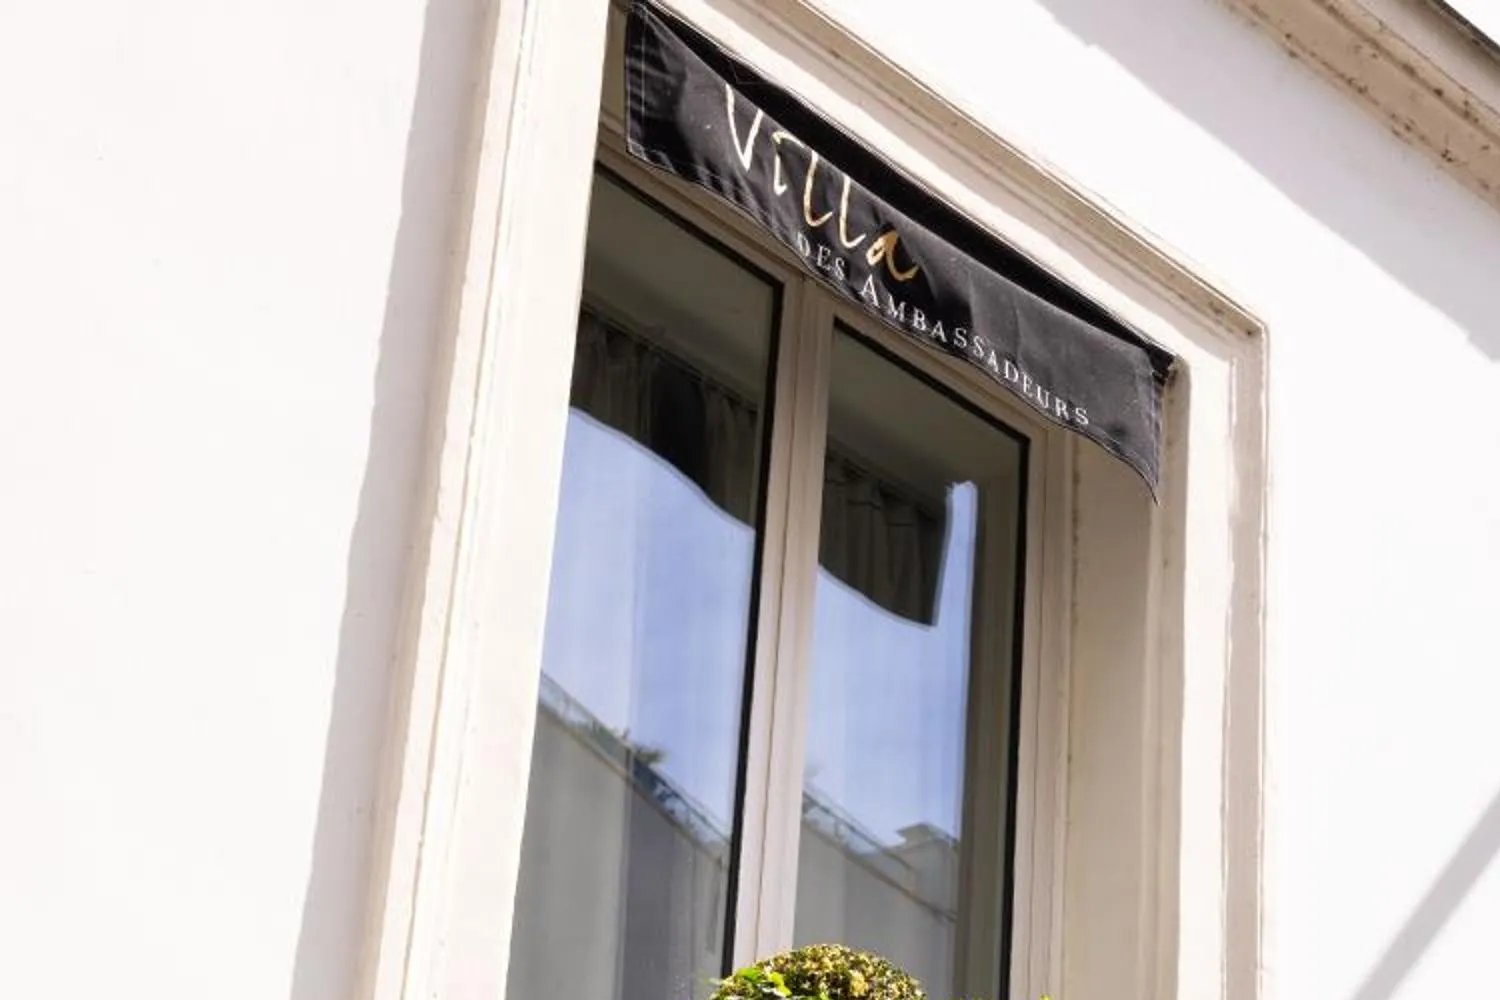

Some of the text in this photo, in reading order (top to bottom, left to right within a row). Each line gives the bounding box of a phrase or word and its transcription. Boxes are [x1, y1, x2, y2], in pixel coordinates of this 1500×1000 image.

[725, 84, 920, 281] Villa
[797, 232, 1089, 427] DES AMBASSADEURS
